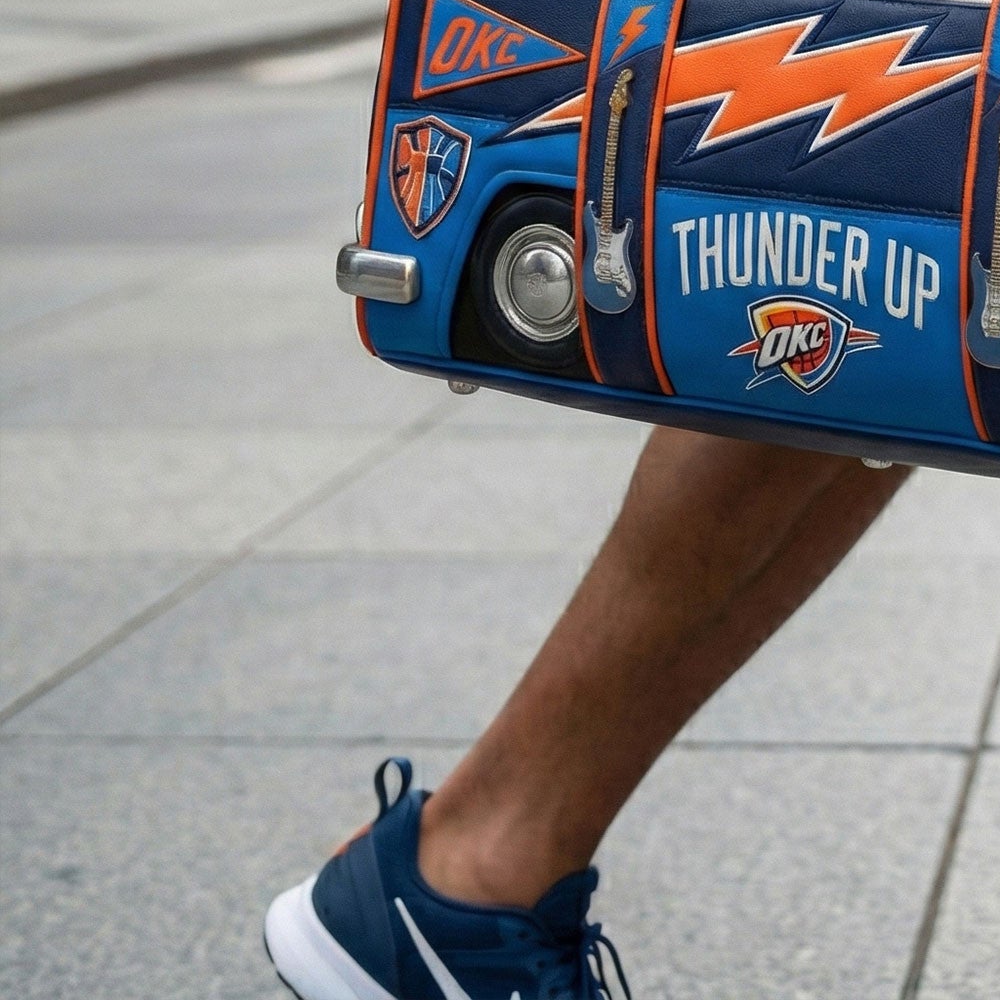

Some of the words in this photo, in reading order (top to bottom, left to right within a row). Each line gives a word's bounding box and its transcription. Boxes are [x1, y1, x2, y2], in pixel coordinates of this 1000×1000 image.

[428, 16, 527, 76] OKC
[672, 211, 870, 307] THUNDER
[883, 237, 941, 331] UP
[756, 320, 828, 369] OKC
